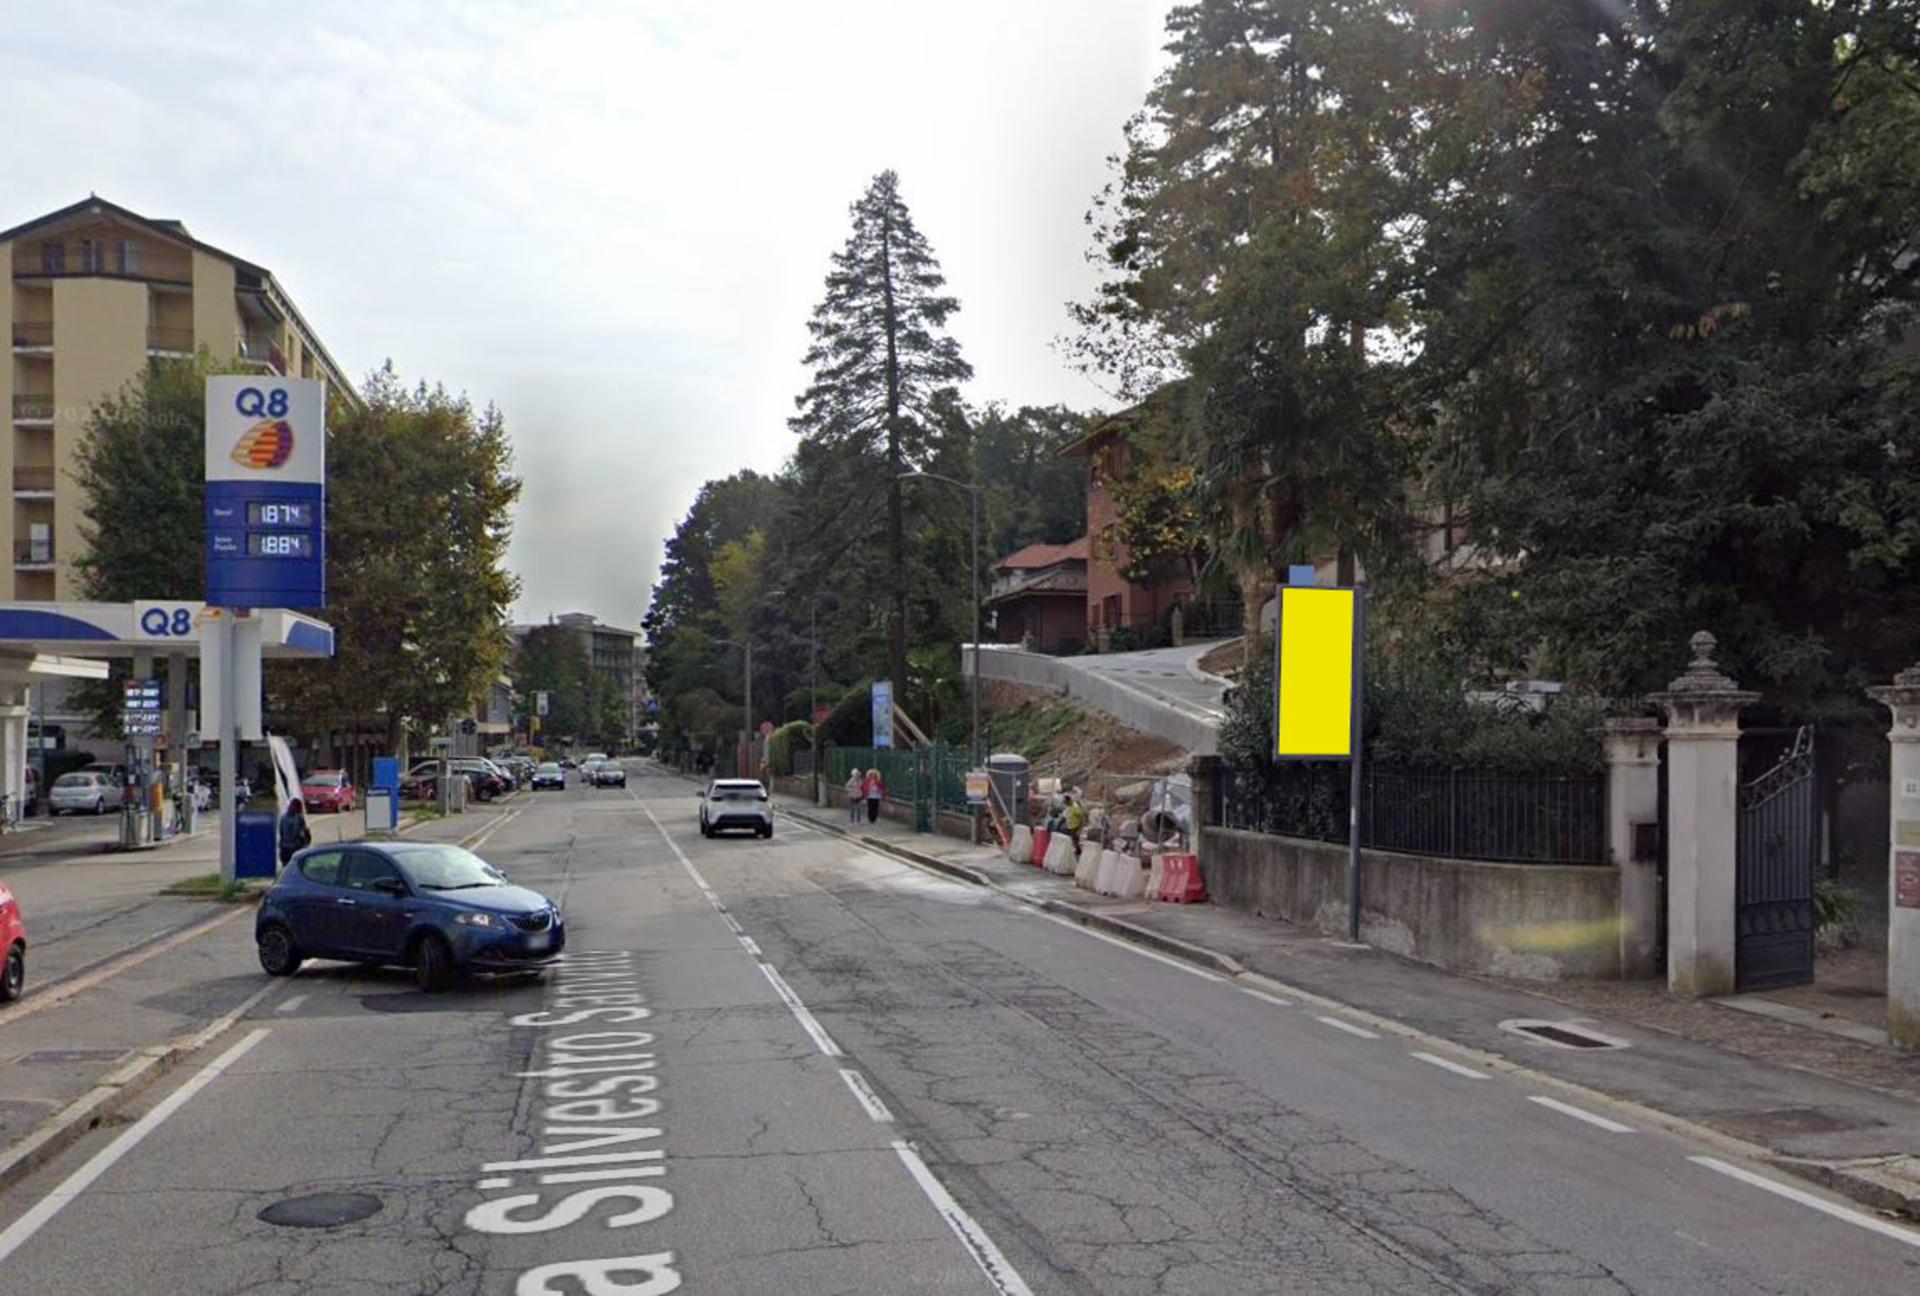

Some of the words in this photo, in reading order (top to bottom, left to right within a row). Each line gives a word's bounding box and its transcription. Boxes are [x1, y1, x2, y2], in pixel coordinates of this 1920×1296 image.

[236, 387, 289, 418] Q8
[141, 607, 191, 636] Q8
[465, 1032, 674, 1233] Silvestro
